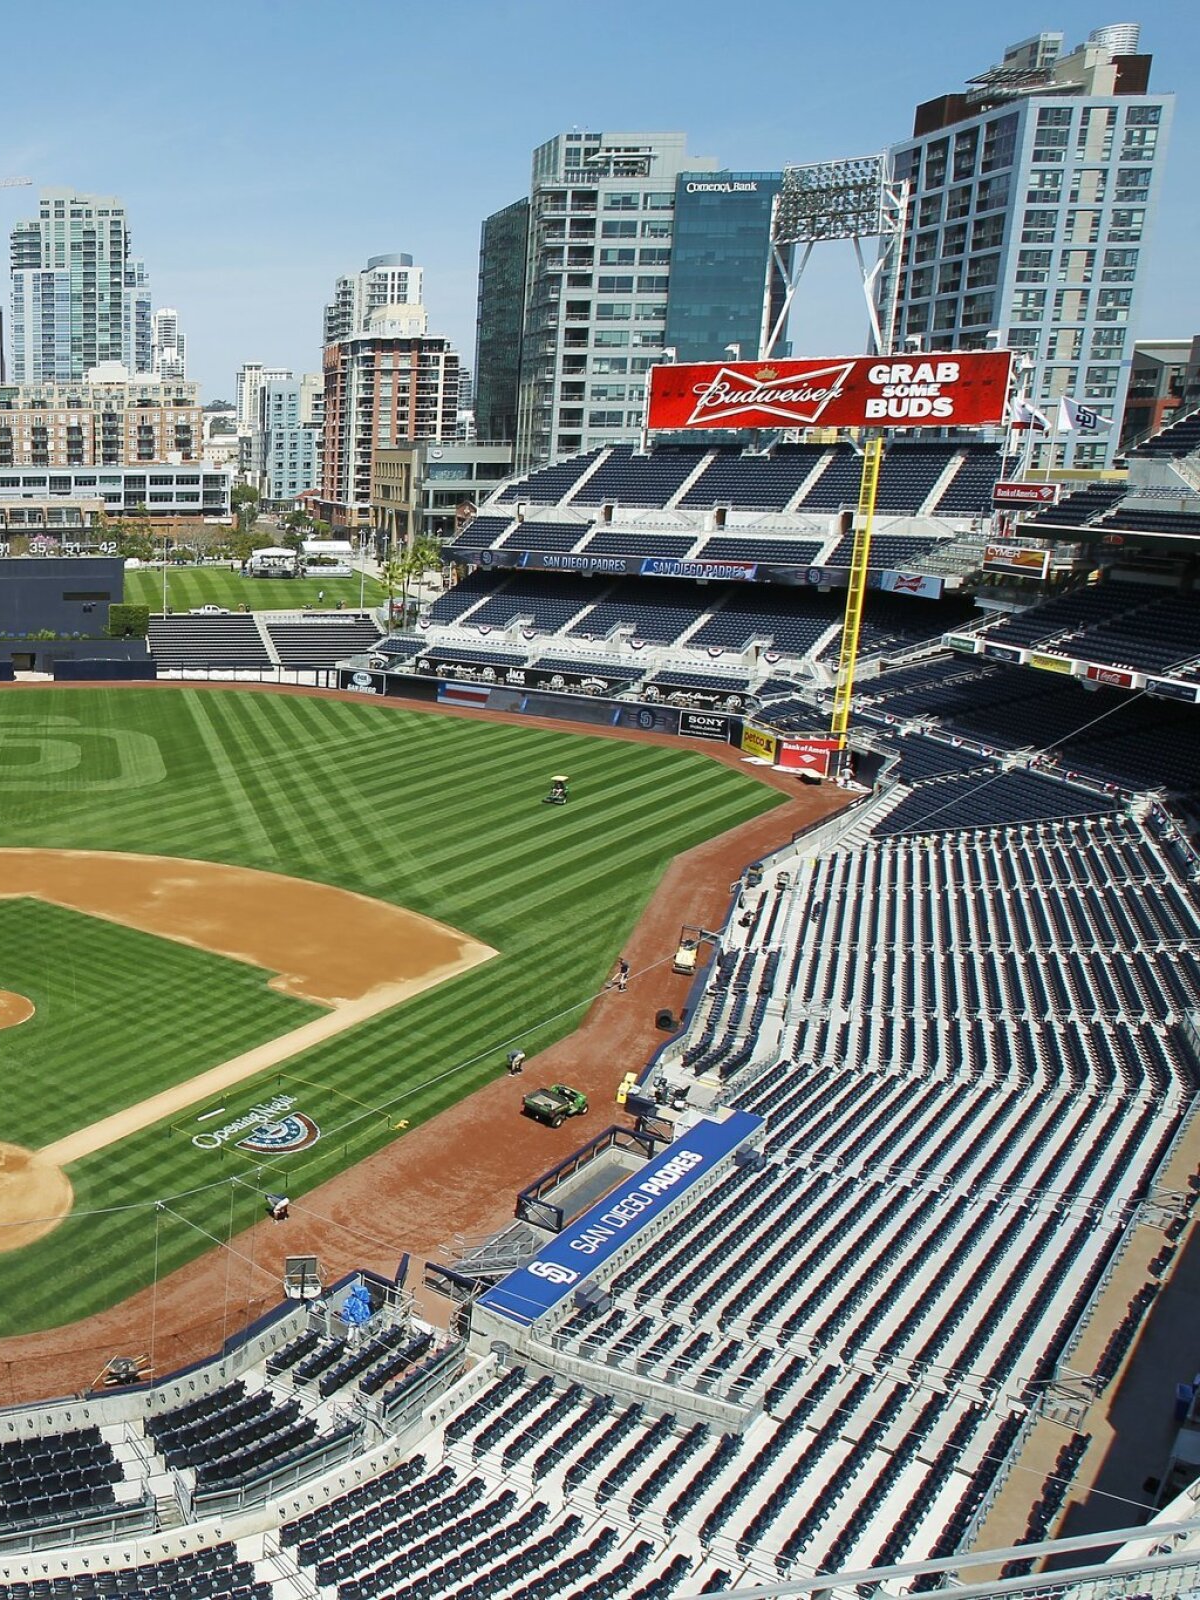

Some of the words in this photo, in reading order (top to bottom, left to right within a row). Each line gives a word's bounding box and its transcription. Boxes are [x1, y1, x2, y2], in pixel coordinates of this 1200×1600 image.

[733, 181, 757, 191] Bank
[868, 362, 959, 385] GRAB
[693, 382, 843, 407] Budweiser
[882, 384, 940, 398] SOME
[865, 397, 954, 418] BUDS
[997, 488, 1010, 497] Bank
[1016, 489, 1038, 498] America
[29, 542, 47, 553] 35
[99, 541, 118, 553] 42
[987, 547, 1021, 558] CYMER
[543, 555, 560, 568] SAN
[562, 557, 589, 570] DIEGO
[591, 558, 627, 572] PADRES
[652, 561, 671, 574] SAN
[673, 562, 702, 576] DIEGO
[705, 564, 746, 579] PADRES
[688, 715, 725, 726] SONY
[744, 732, 765, 746] petco
[783, 742, 799, 750] Bank
[192, 1111, 269, 1149] Opening
[249, 1094, 298, 1122] Night
[569, 1223, 616, 1255] SAN
[599, 1191, 654, 1228] DIEGO
[639, 1149, 704, 1197] PADRES
